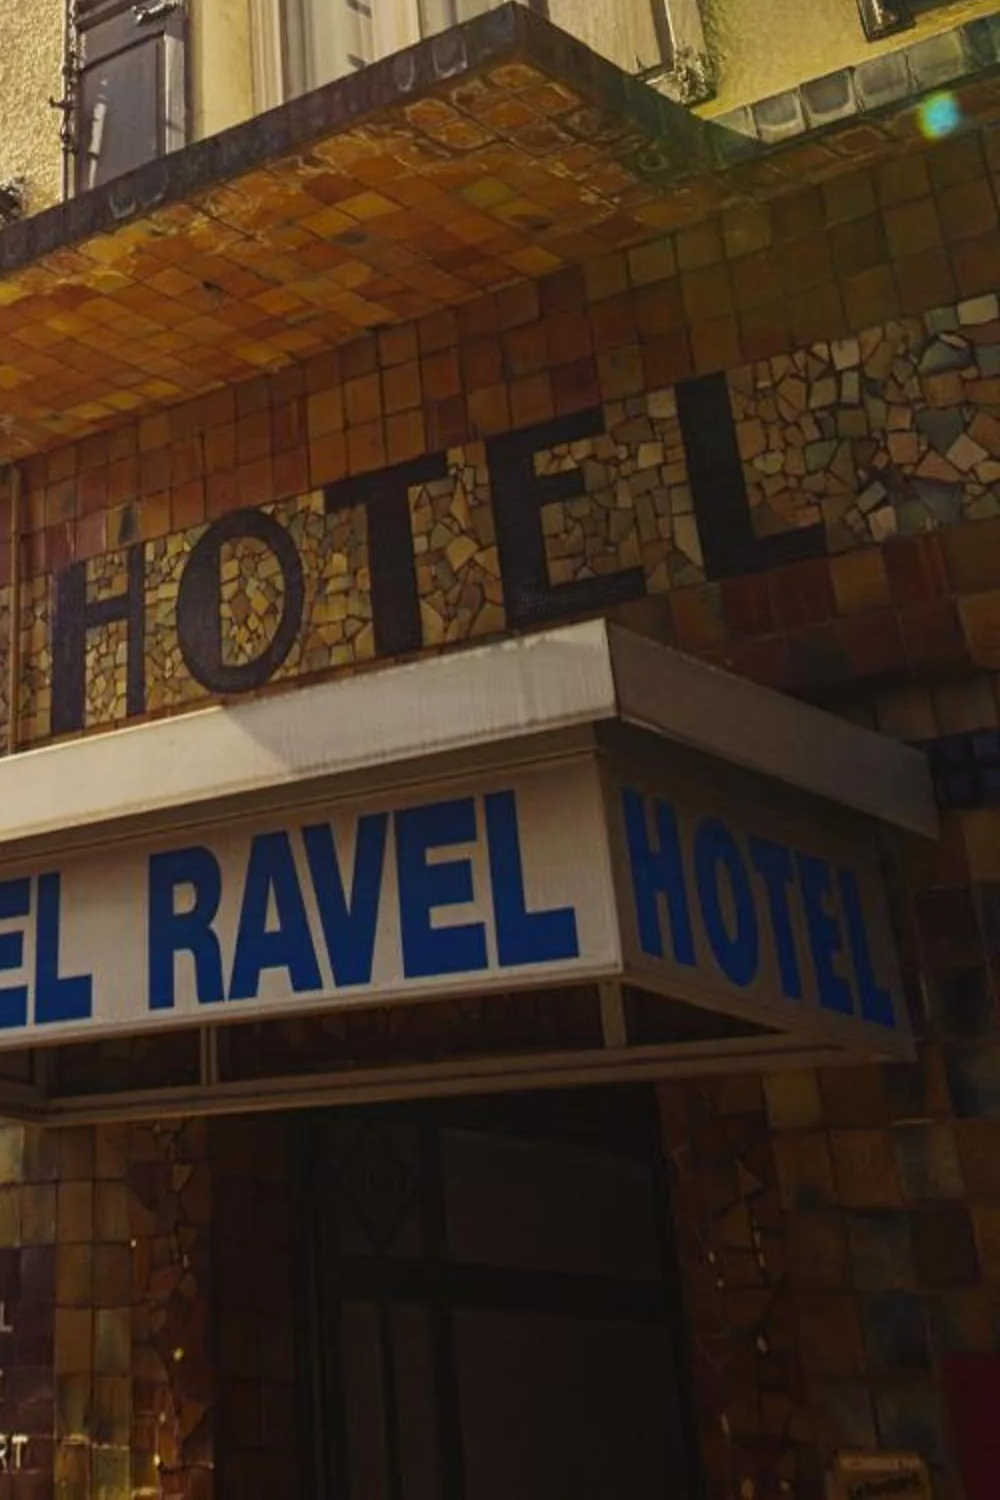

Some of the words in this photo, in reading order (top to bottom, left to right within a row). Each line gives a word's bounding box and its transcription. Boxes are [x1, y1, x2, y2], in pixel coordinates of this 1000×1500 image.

[50, 371, 827, 735] HOTEL
[148, 789, 580, 1012] RAVEL
[620, 786, 897, 1030] HOTEL
